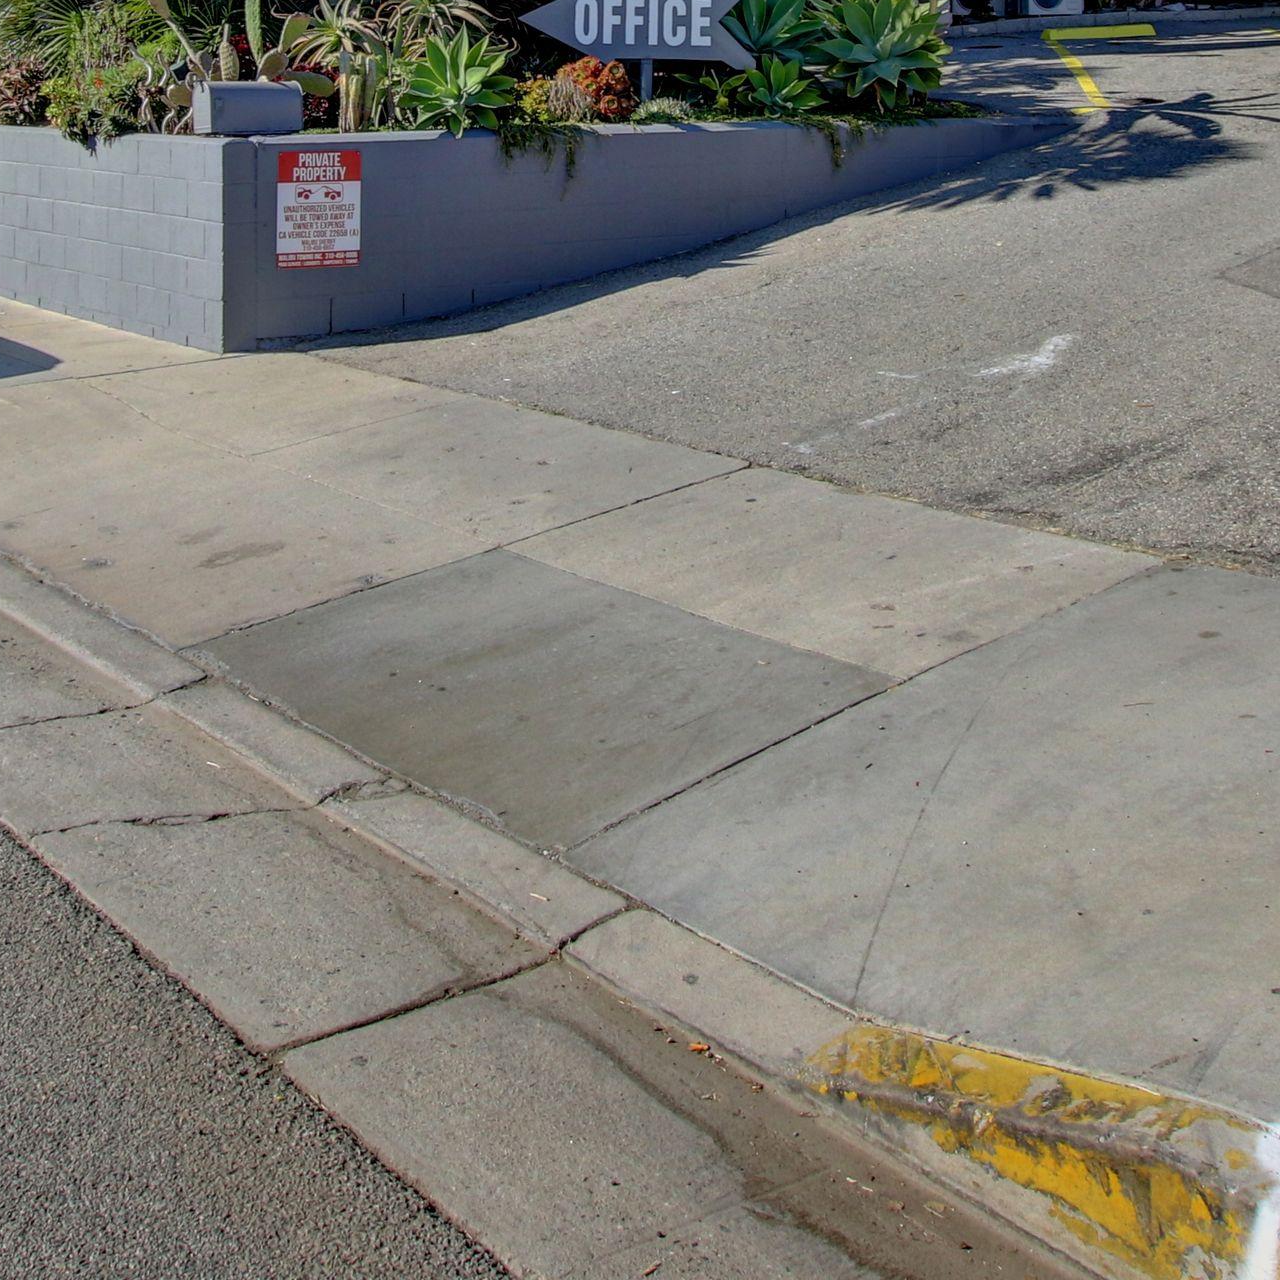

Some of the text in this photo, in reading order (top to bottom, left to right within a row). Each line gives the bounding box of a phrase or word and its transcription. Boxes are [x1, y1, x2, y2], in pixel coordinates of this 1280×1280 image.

[298, 152, 341, 166] PRIVATE
[293, 167, 346, 181] PROPERTY
[283, 203, 355, 213] UNAUTHORIZED VEHICLES
[309, 213, 328, 221] TOWED
[330, 212, 346, 220] AWAY
[347, 211, 354, 219] AT
[278, 231, 287, 239] CA
[288, 230, 311, 238] VEHICLE
[312, 229, 328, 237] CODE
[349, 228, 359, 237] (A)
